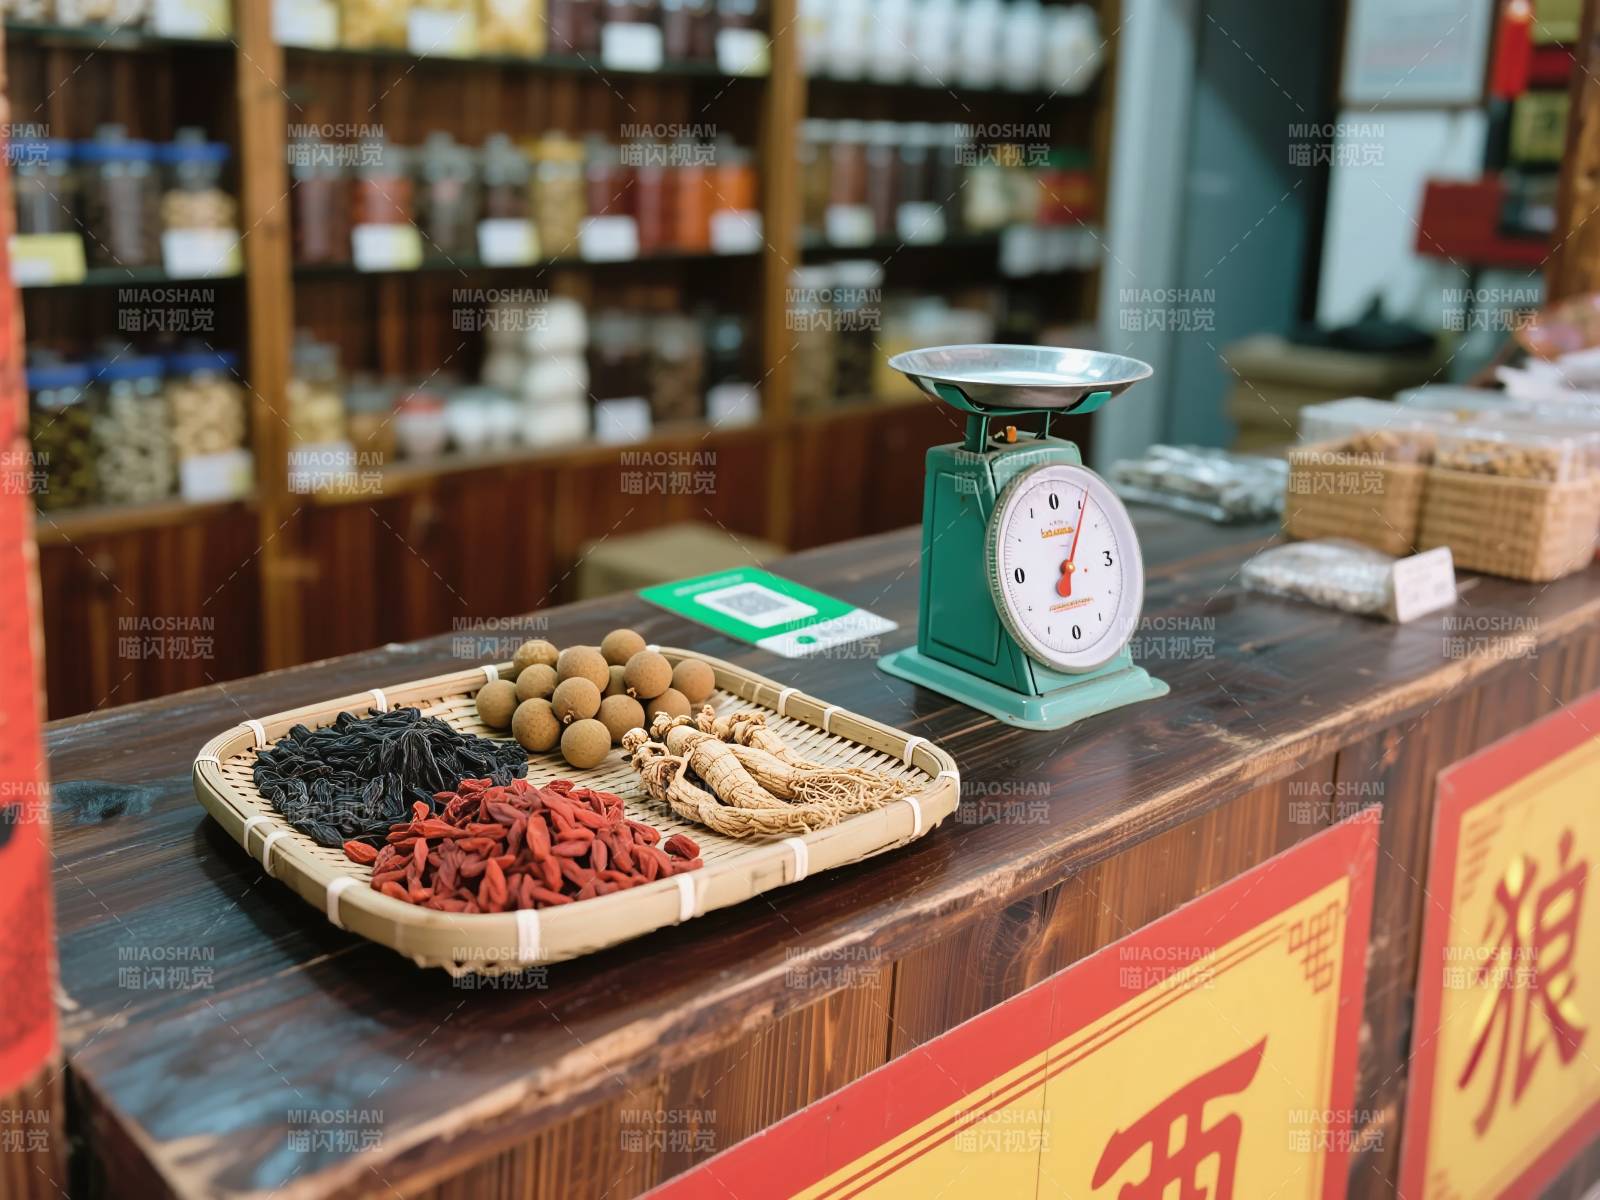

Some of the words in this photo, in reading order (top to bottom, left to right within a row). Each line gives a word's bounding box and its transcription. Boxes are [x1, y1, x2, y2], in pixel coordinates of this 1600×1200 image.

[1048, 493, 1059, 510] 0
[1102, 550, 1112, 566] 3
[1014, 568, 1025, 584] 0
[1072, 624, 1081, 640] 0
[1457, 826, 1590, 1139] 狼
